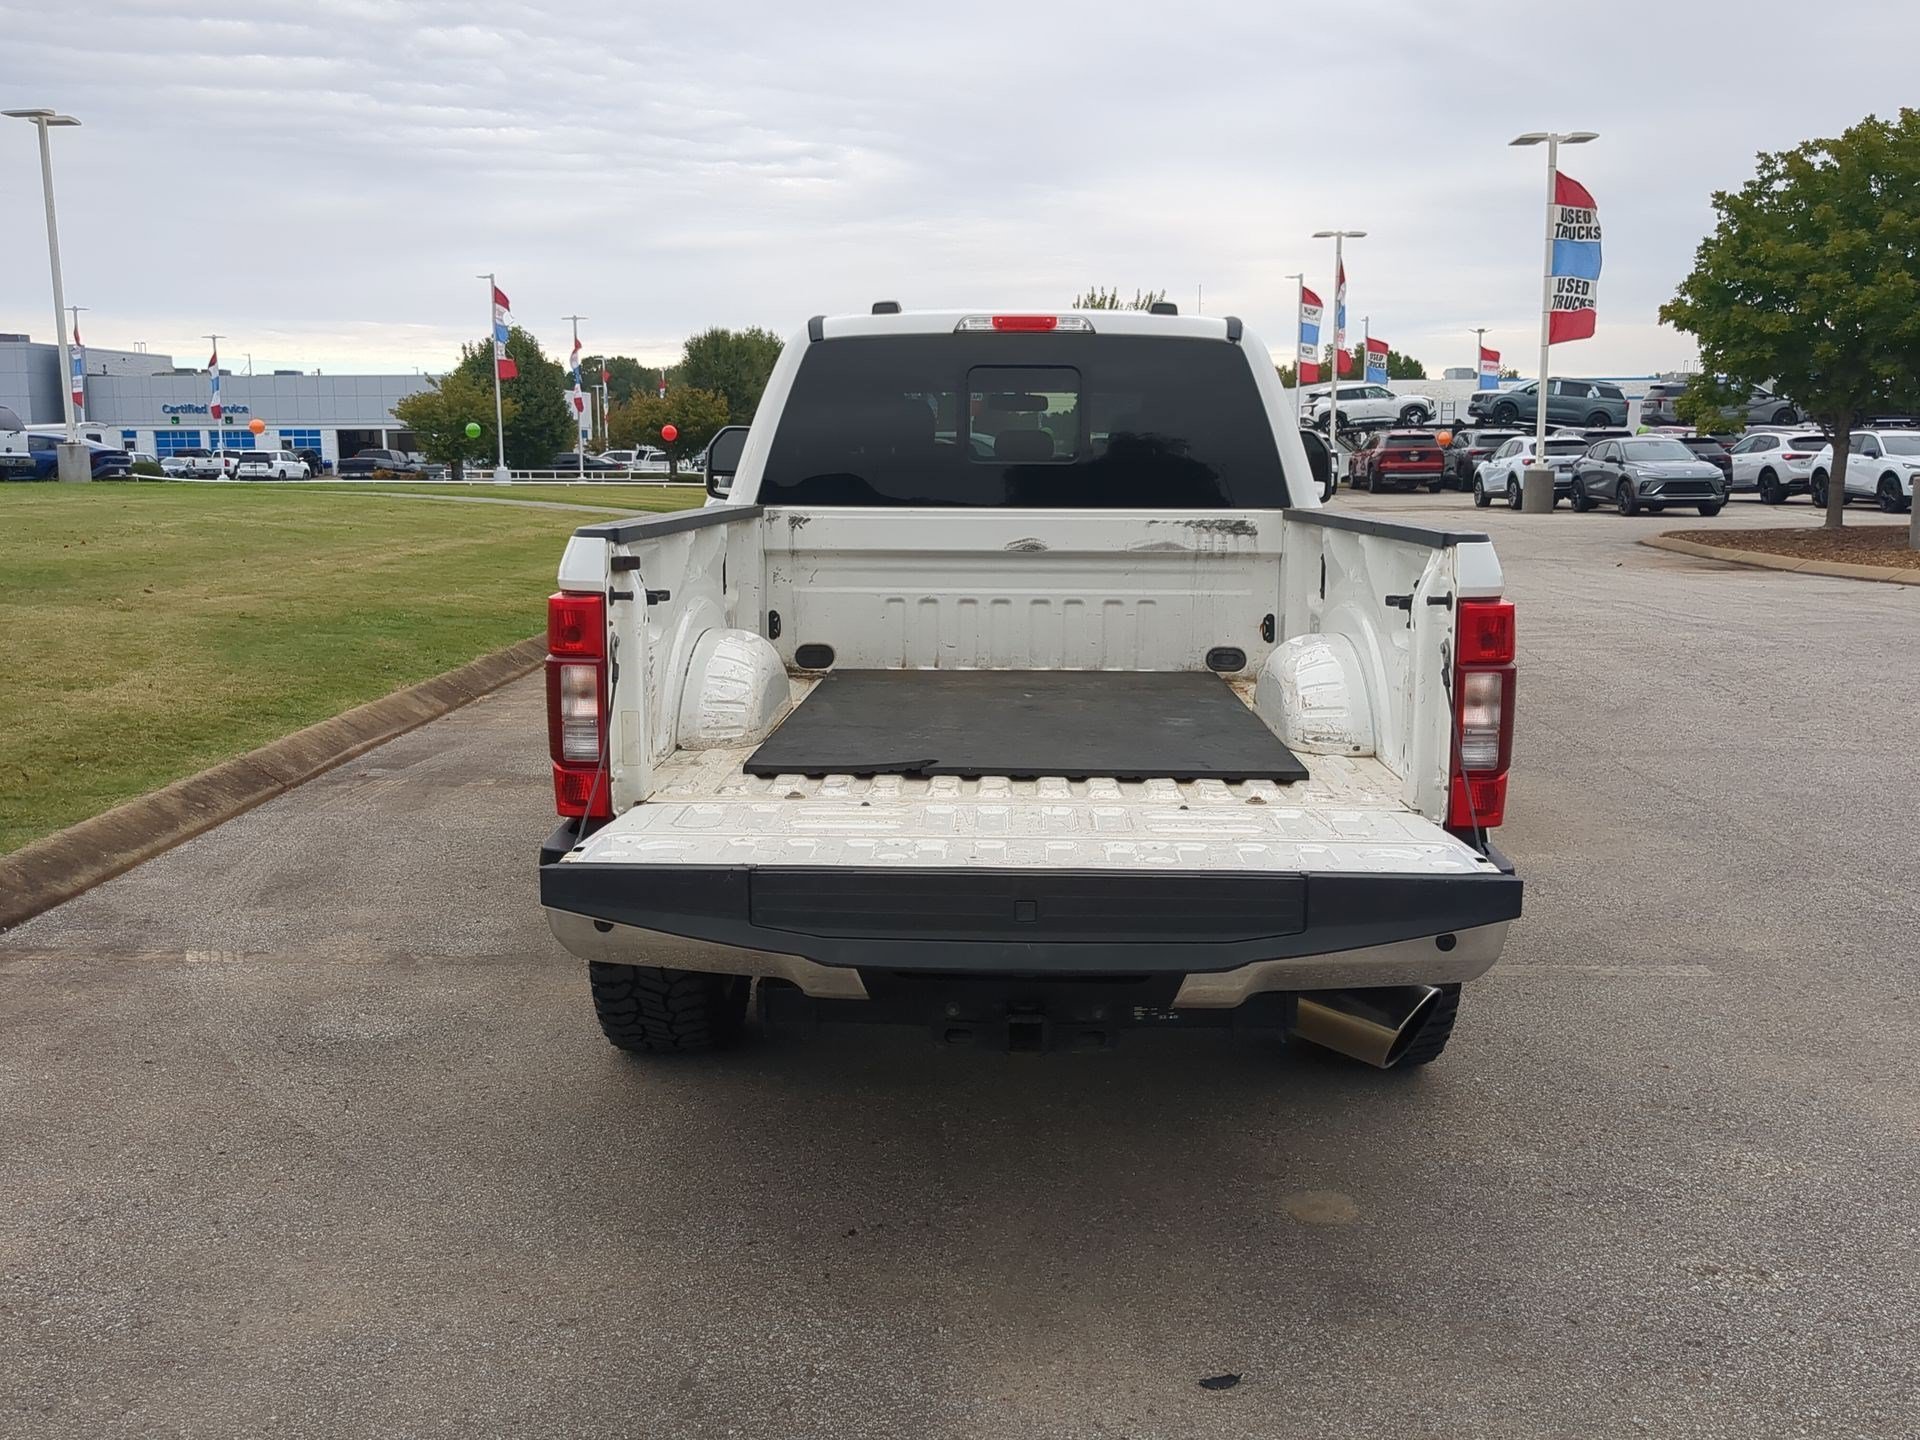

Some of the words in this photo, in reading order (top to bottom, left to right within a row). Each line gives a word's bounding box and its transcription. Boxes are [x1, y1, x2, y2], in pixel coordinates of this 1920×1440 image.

[1560, 207, 1592, 224] USED
[1555, 222, 1601, 240] TRUCKS
[1557, 278, 1590, 295] USED
[1552, 294, 1594, 311] TRUCKS
[162, 404, 207, 414] Certified
[215, 404, 248, 414] rvice
